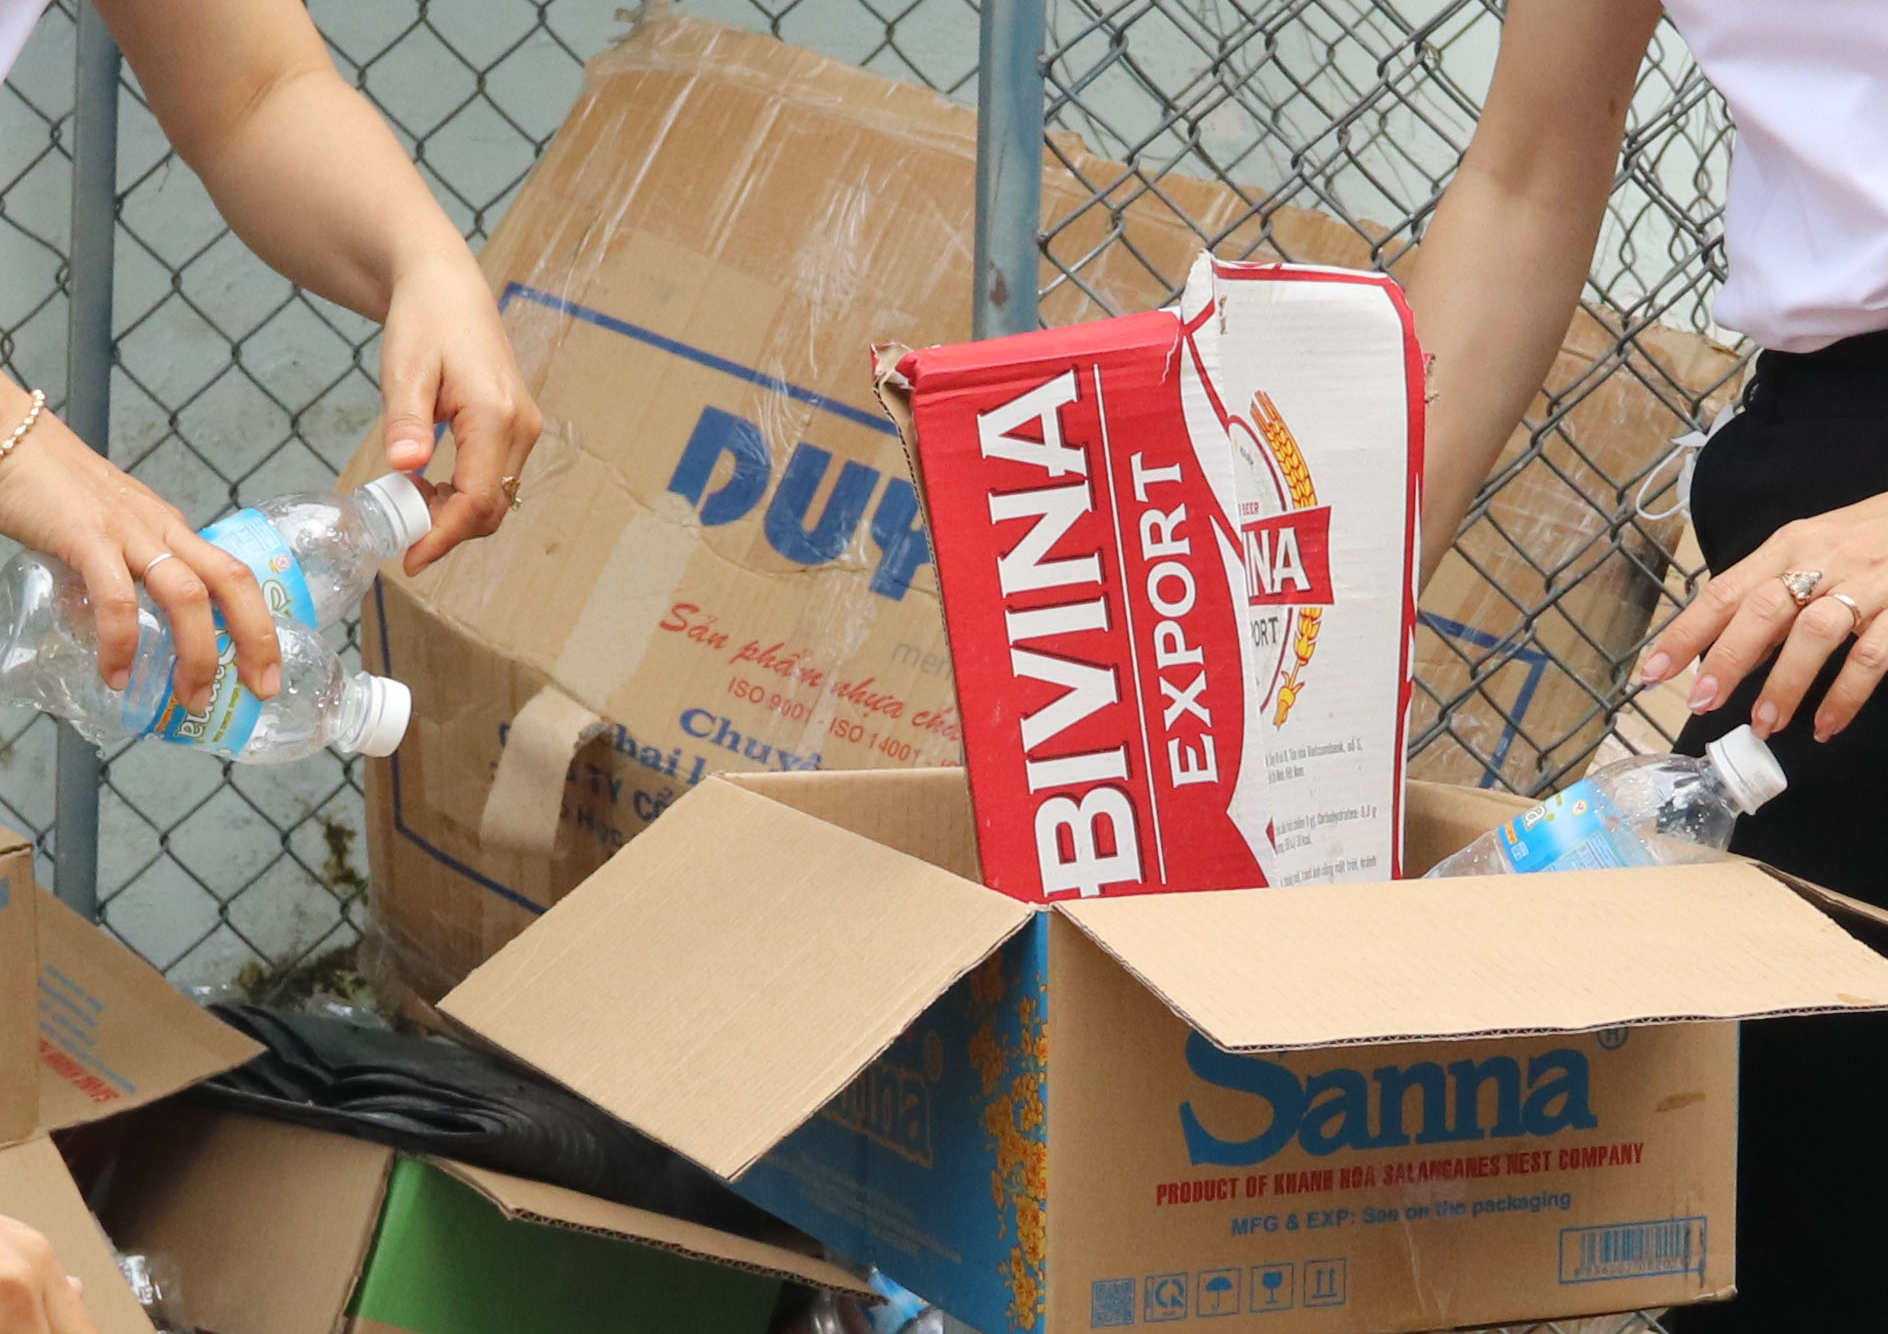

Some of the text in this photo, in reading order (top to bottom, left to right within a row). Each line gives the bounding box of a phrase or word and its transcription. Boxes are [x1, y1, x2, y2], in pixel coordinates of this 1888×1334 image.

[977, 365, 1148, 899] BIVINA
[1129, 451, 1219, 787] EXPORT
[728, 677, 921, 761] ISO 9001 ISO 14001
[1179, 1027, 1599, 1167] Sanna
[1156, 1177, 1240, 1205] PRODUCT
[1246, 1174, 1268, 1197] OF
[1382, 1154, 1500, 1186] SALANGANES
[1507, 1149, 1552, 1175] NEST
[1558, 1142, 1644, 1171] COMPANY
[1231, 1215, 1279, 1236] MFG
[1285, 1213, 1300, 1231] &
[1307, 1208, 1356, 1230] EXP:
[1405, 1202, 1429, 1219] on
[1435, 1199, 1466, 1216] the
[1472, 1191, 1572, 1217] packaging
